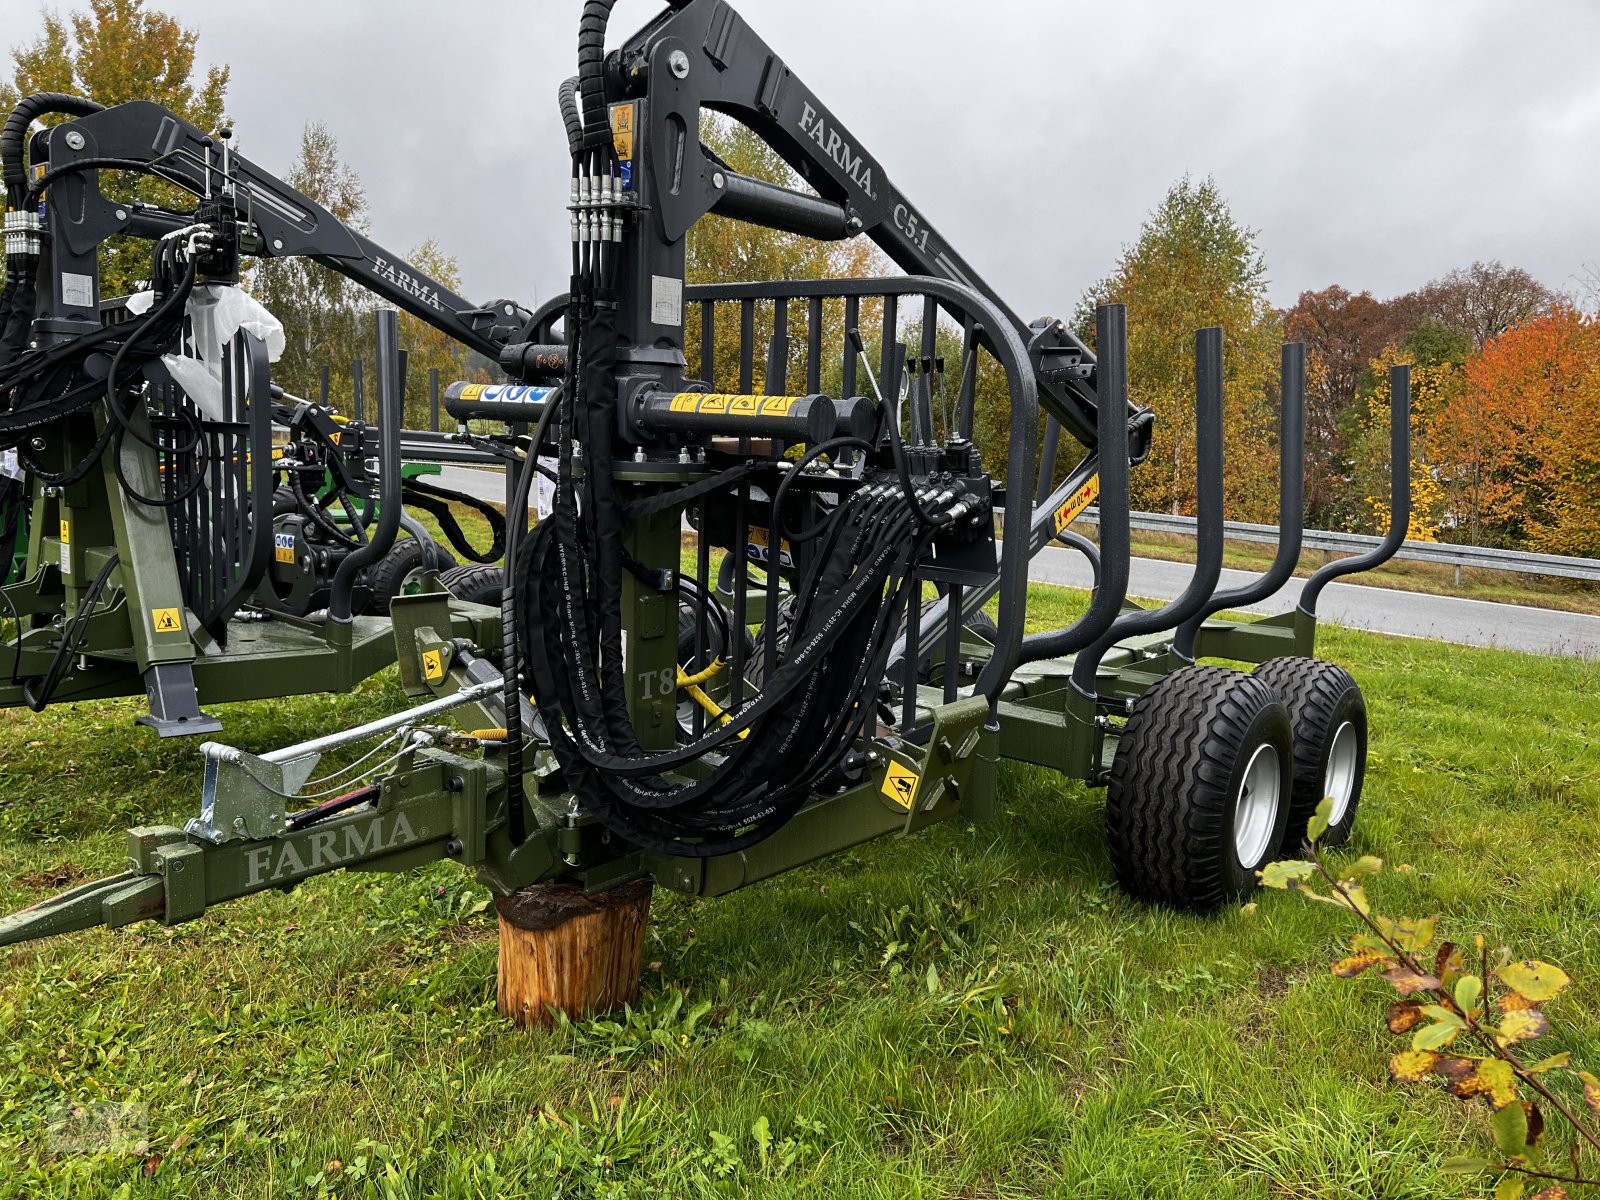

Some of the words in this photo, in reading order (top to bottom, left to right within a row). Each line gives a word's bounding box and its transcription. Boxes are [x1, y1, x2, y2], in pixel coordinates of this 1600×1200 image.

[798, 101, 872, 197] FARMA
[893, 204, 930, 254] C5.1
[371, 255, 440, 310] FARMA
[821, 608, 844, 634] IC-293/1
[840, 591, 858, 610] MSHA
[638, 667, 675, 700] T8
[244, 811, 418, 888] FARMA
